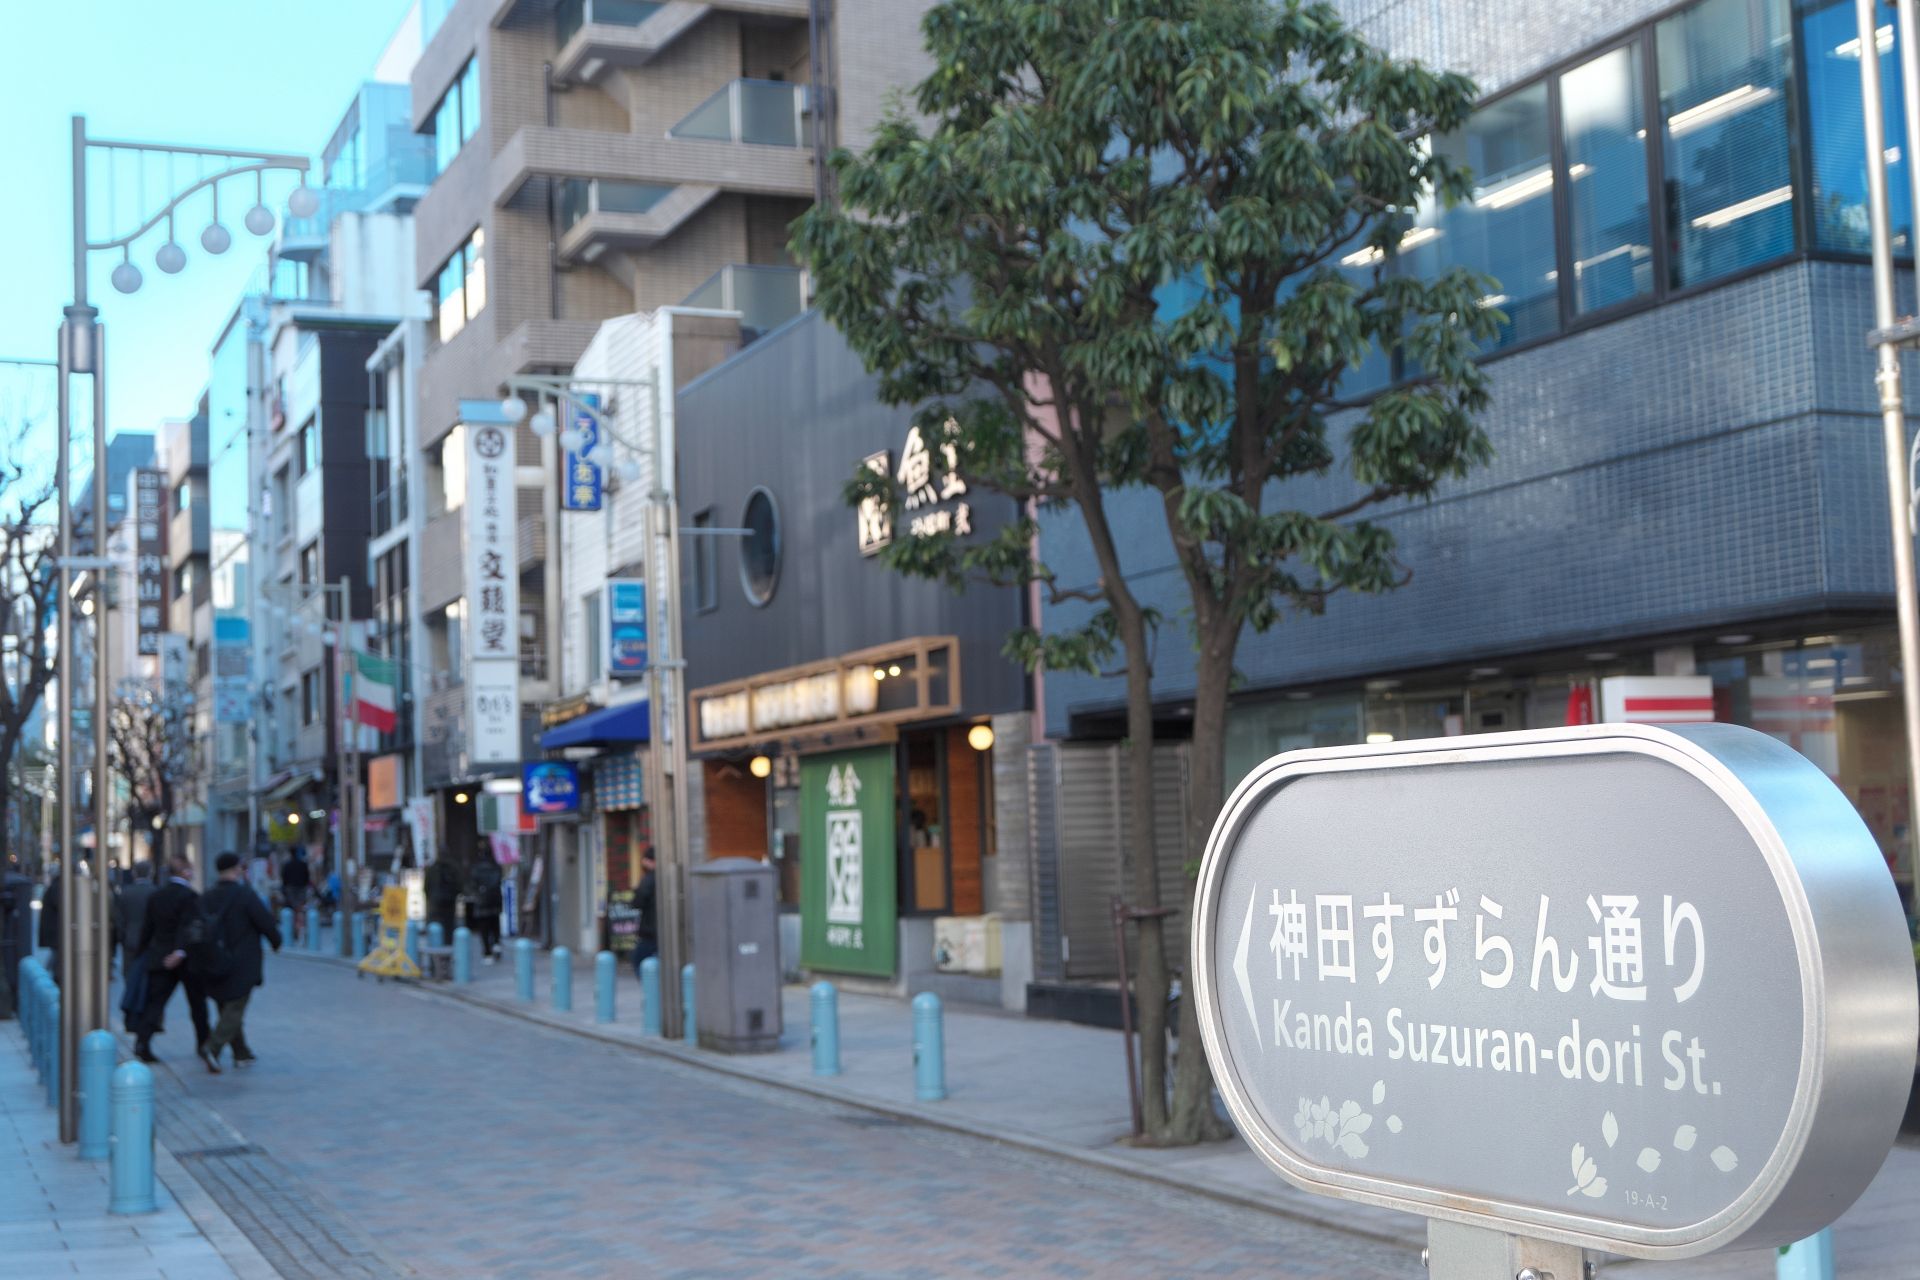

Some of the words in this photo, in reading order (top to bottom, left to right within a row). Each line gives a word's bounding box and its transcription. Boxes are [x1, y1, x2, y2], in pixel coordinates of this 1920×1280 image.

[1269, 886, 1706, 1003] 神田すずらん通り
[1273, 998, 1374, 1058] Kanda
[1386, 1006, 1644, 1087] Suzuran-dori
[1661, 1029, 1722, 1096] St.
[1624, 1189, 1669, 1211] 19-A-2
